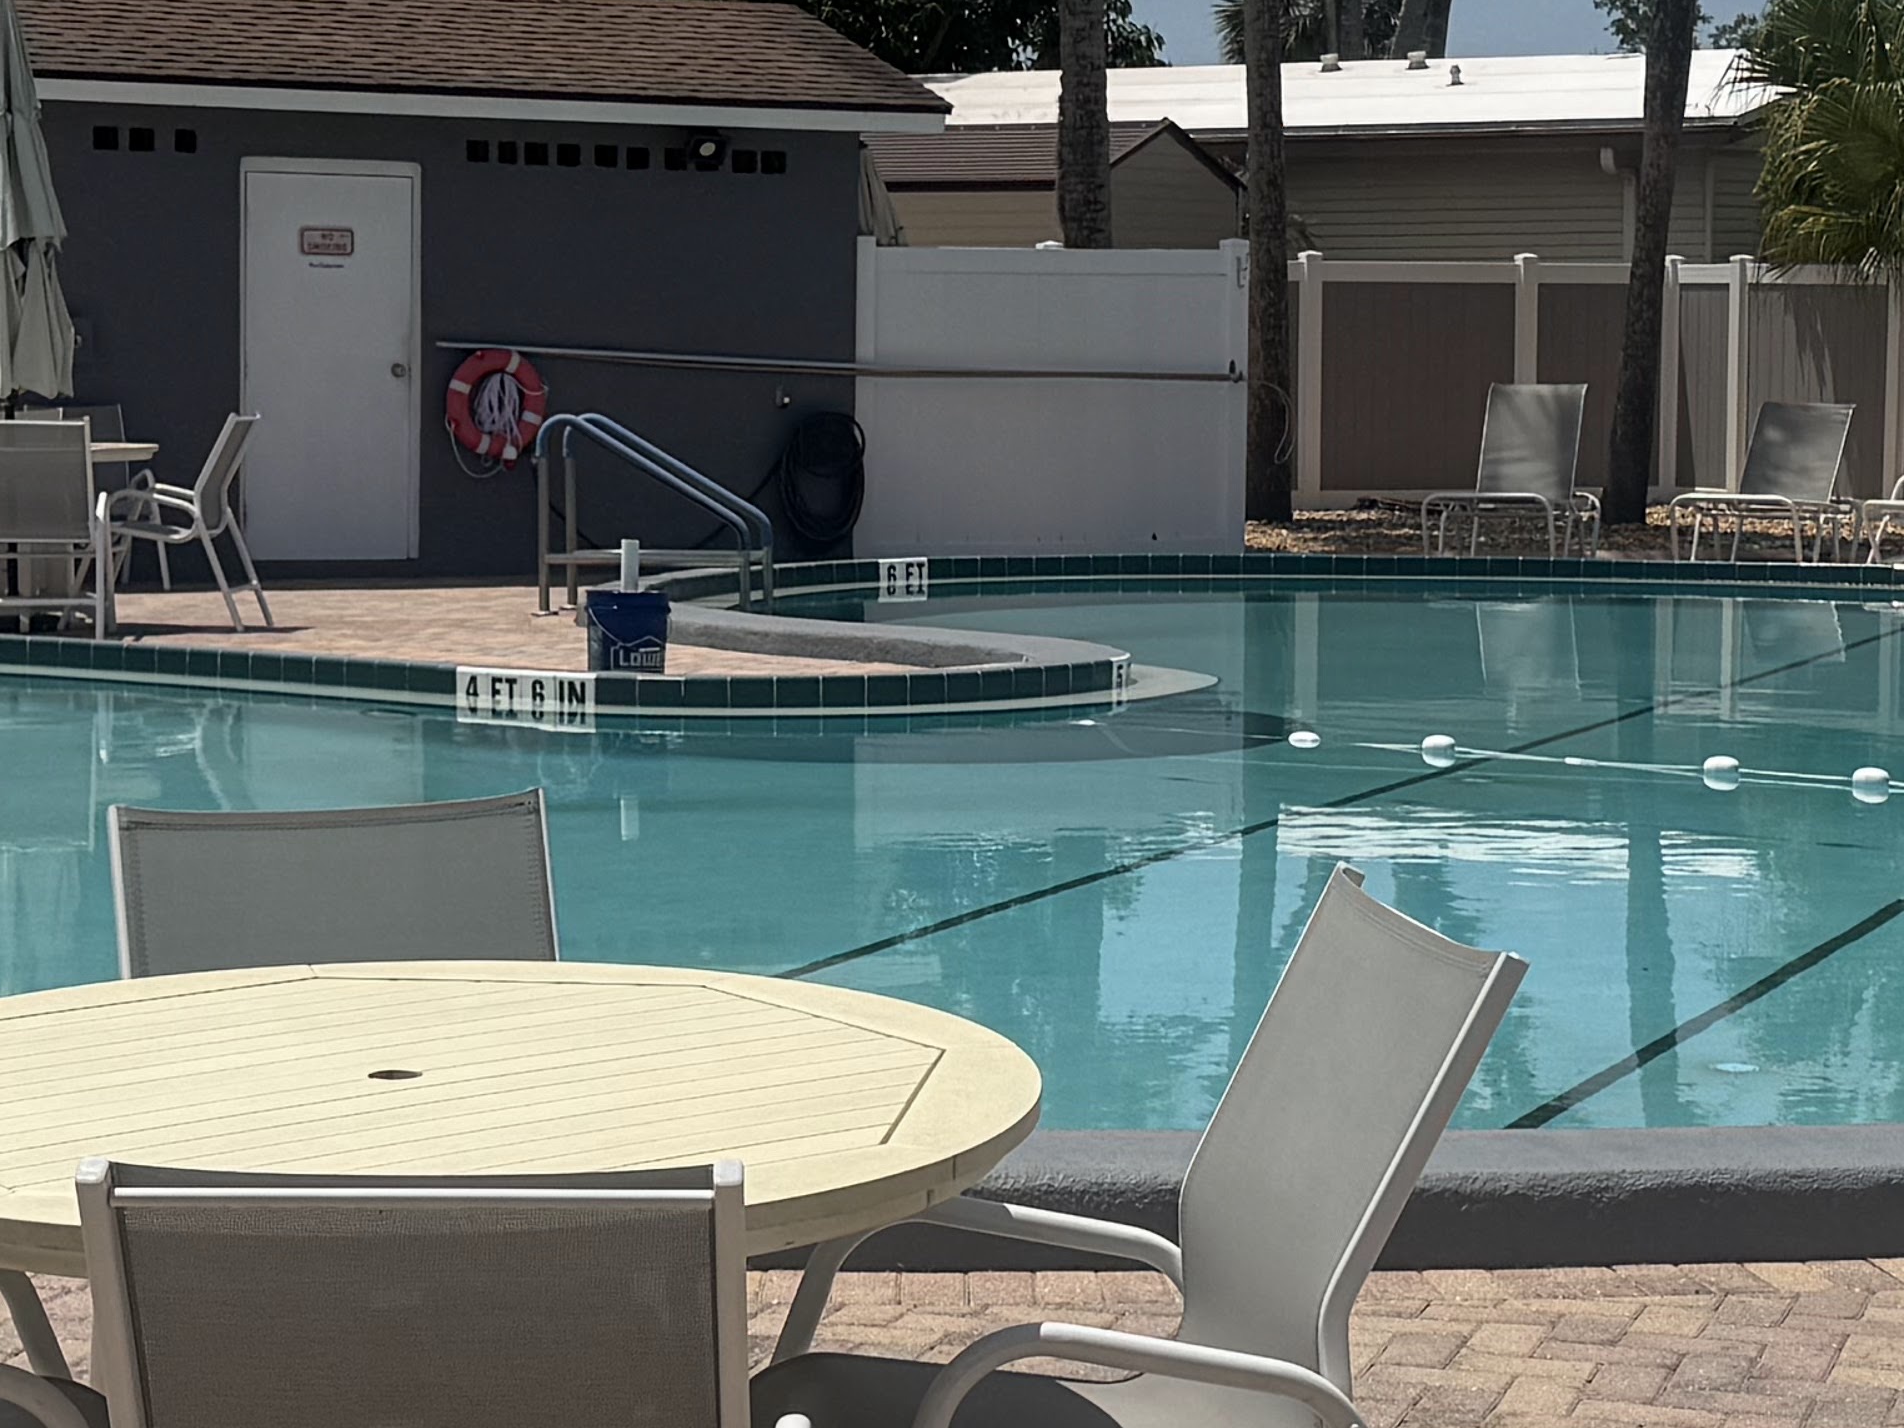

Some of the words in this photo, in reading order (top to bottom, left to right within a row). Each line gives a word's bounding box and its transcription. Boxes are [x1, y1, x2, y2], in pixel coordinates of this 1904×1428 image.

[906, 562, 925, 584] FT
[466, 675, 479, 700] 4
[491, 677, 517, 702] FT
[531, 679, 545, 704] 6
[559, 680, 586, 706] IN
